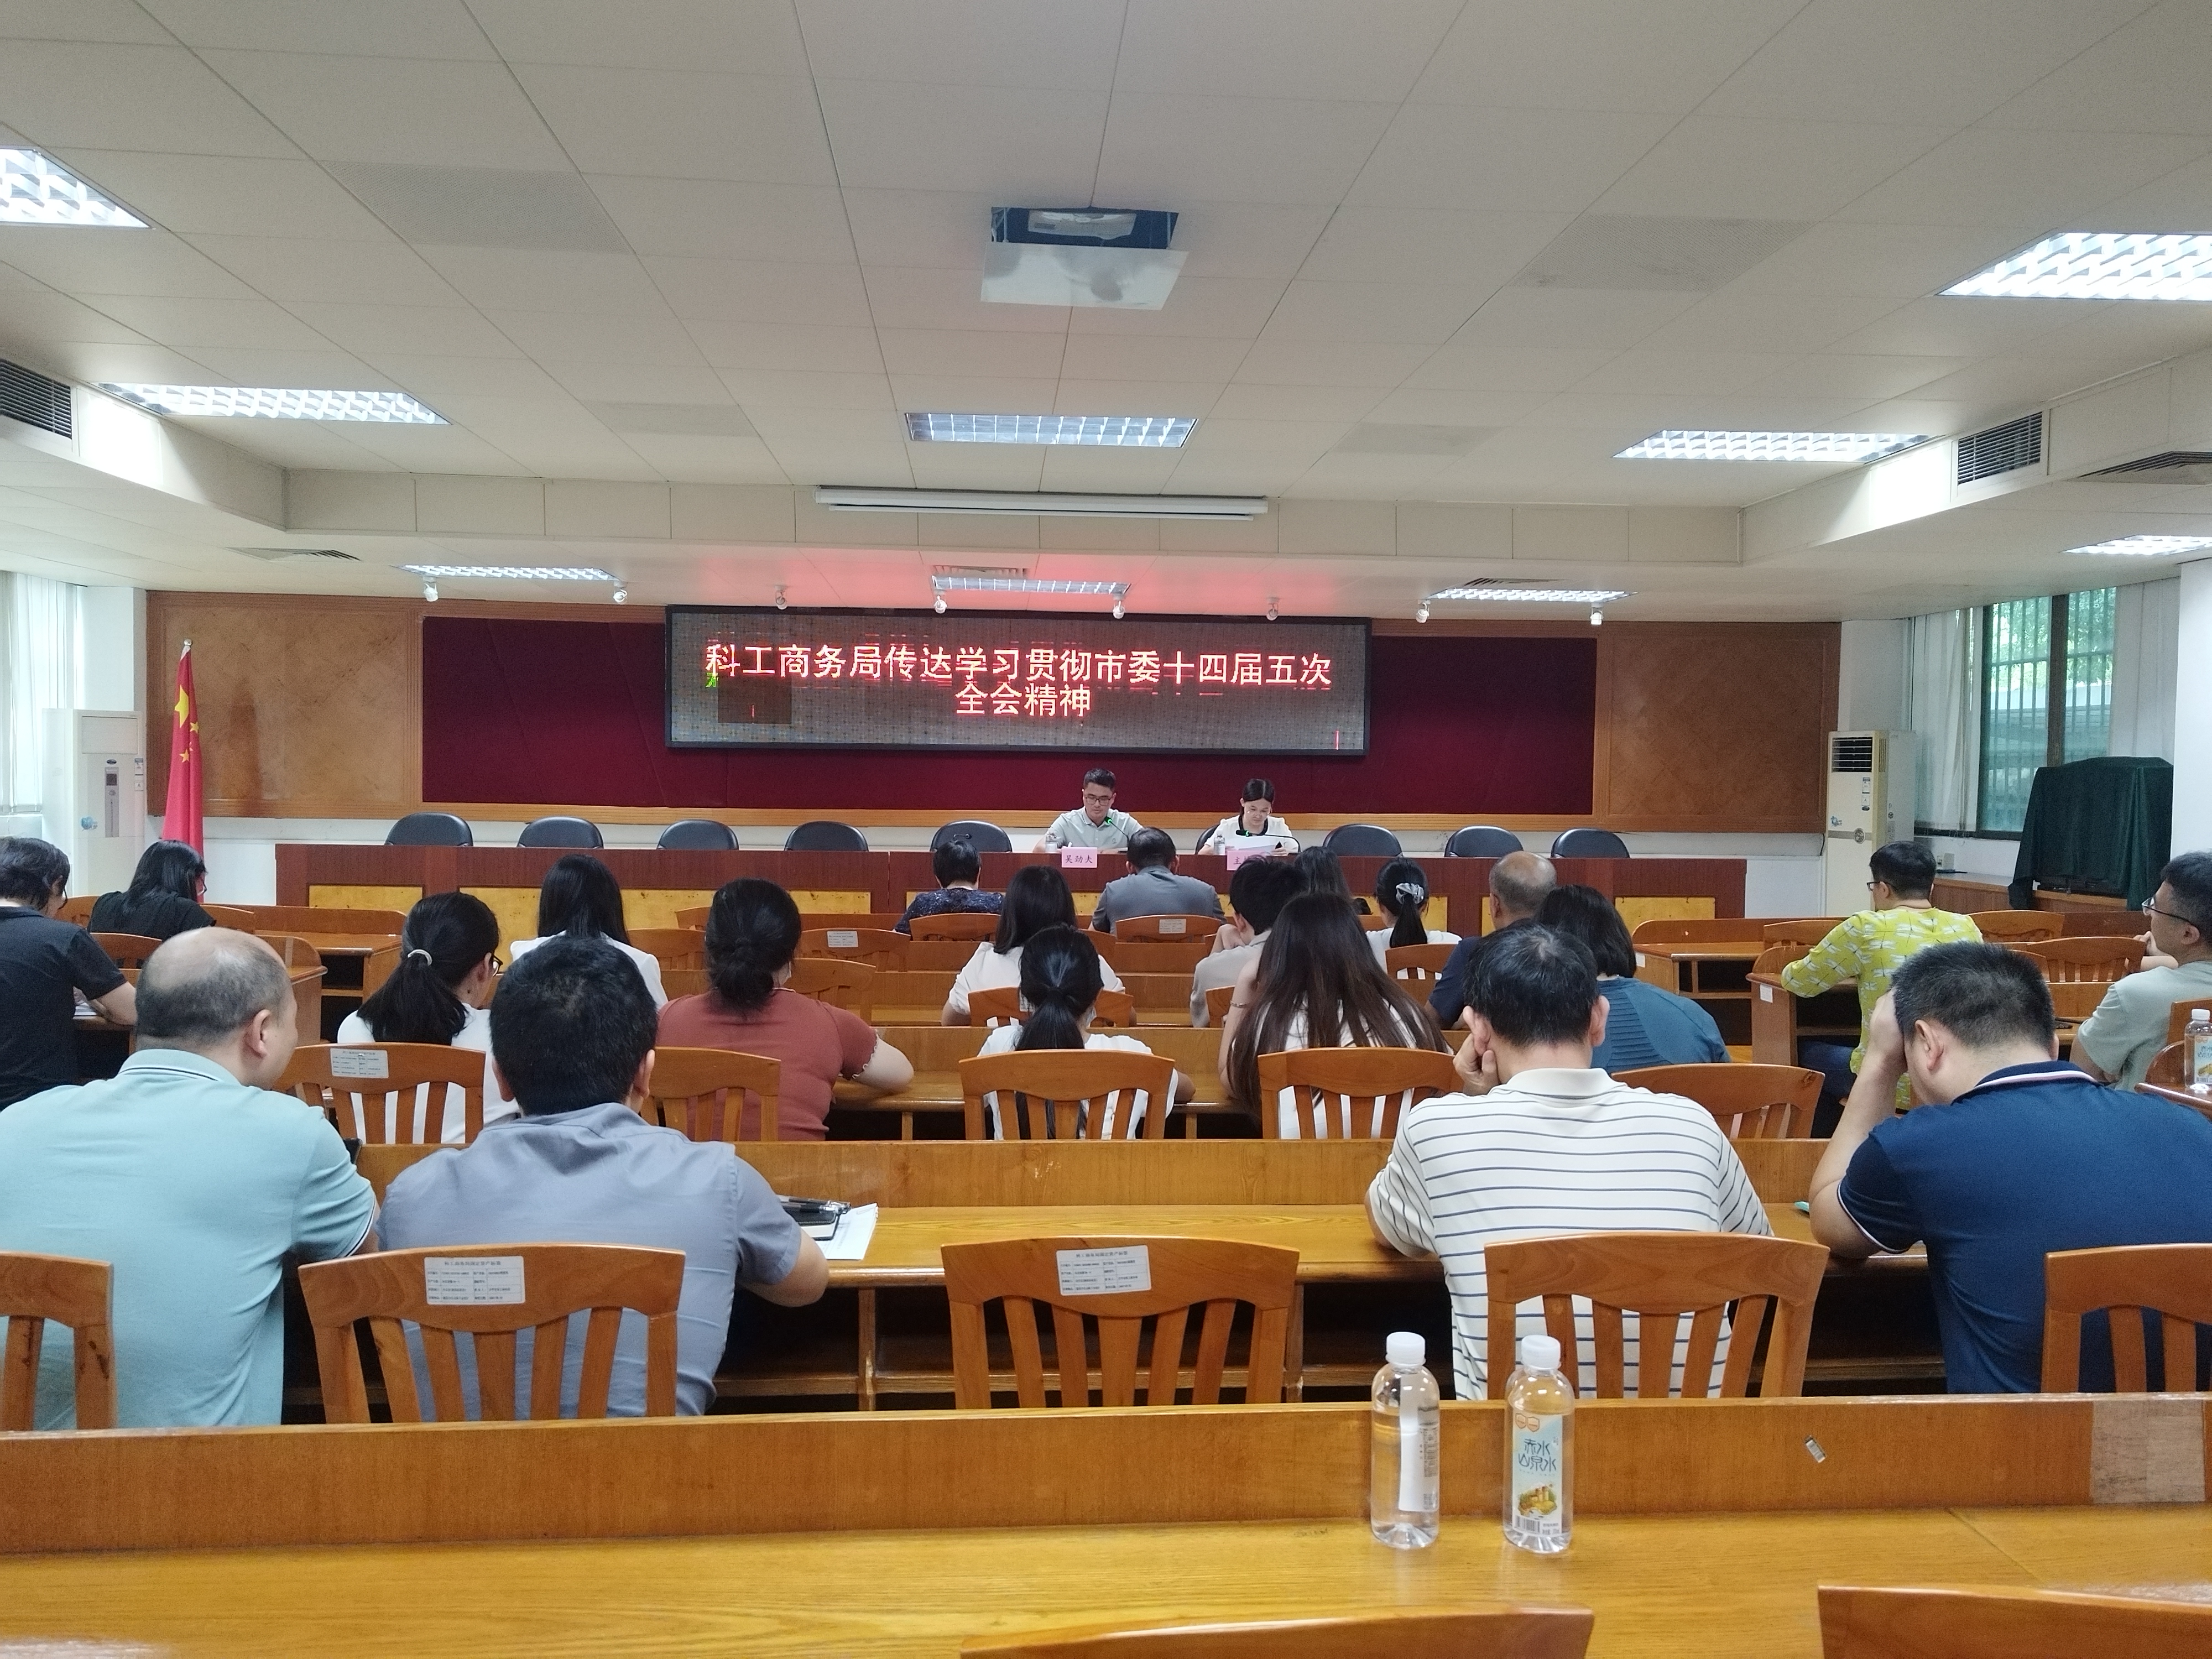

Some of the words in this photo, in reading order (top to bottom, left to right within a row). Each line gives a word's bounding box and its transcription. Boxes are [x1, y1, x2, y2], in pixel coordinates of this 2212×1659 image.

[705, 643, 1332, 686] 科工商务局传达学习贯彻市委十四届五次
[955, 682, 1091, 717] 全会精神
[1524, 1438, 1551, 1457] 赤水
[1517, 1453, 1557, 1472] 山泉水
